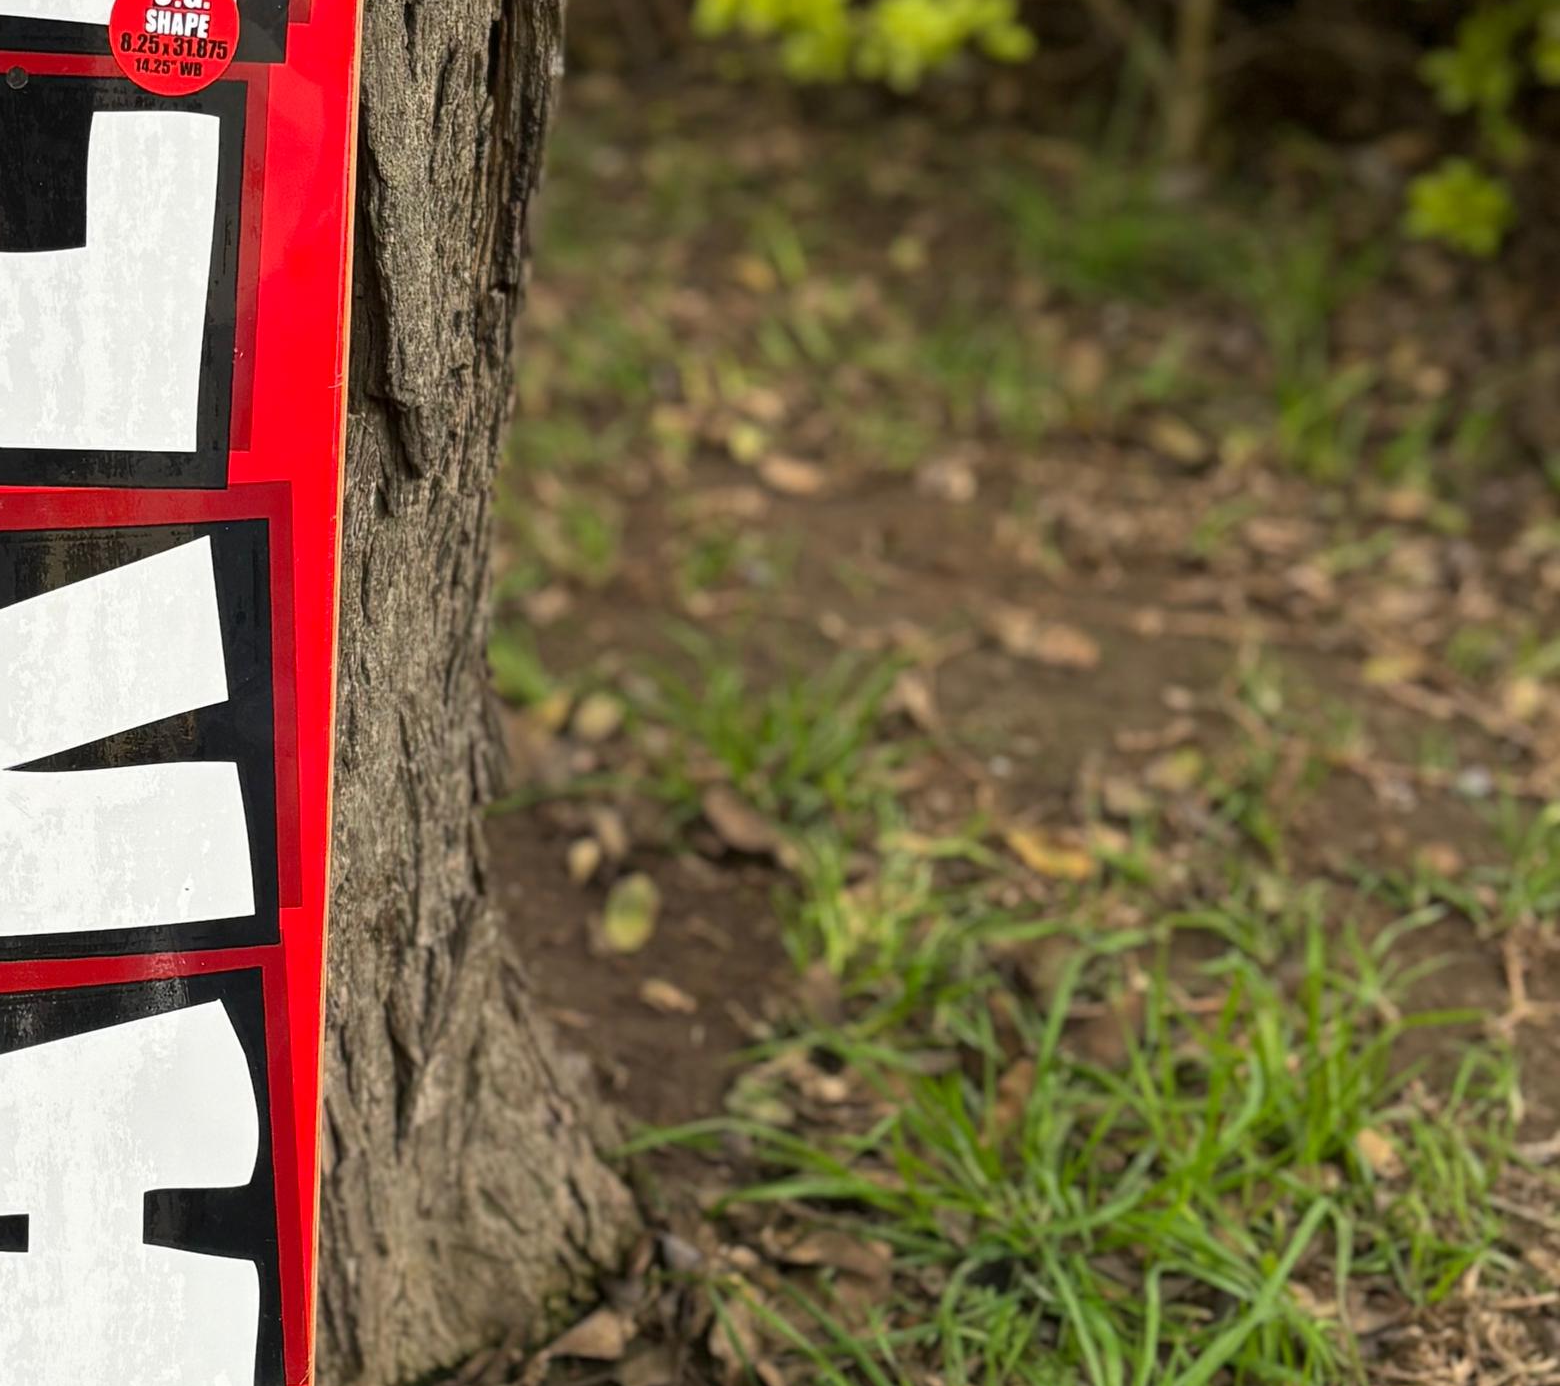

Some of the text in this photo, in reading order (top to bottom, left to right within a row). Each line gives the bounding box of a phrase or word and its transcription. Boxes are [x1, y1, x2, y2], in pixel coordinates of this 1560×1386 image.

[145, 8, 211, 39] SHAPE
[120, 32, 160, 55] 8.25
[179, 61, 203, 78] WB
